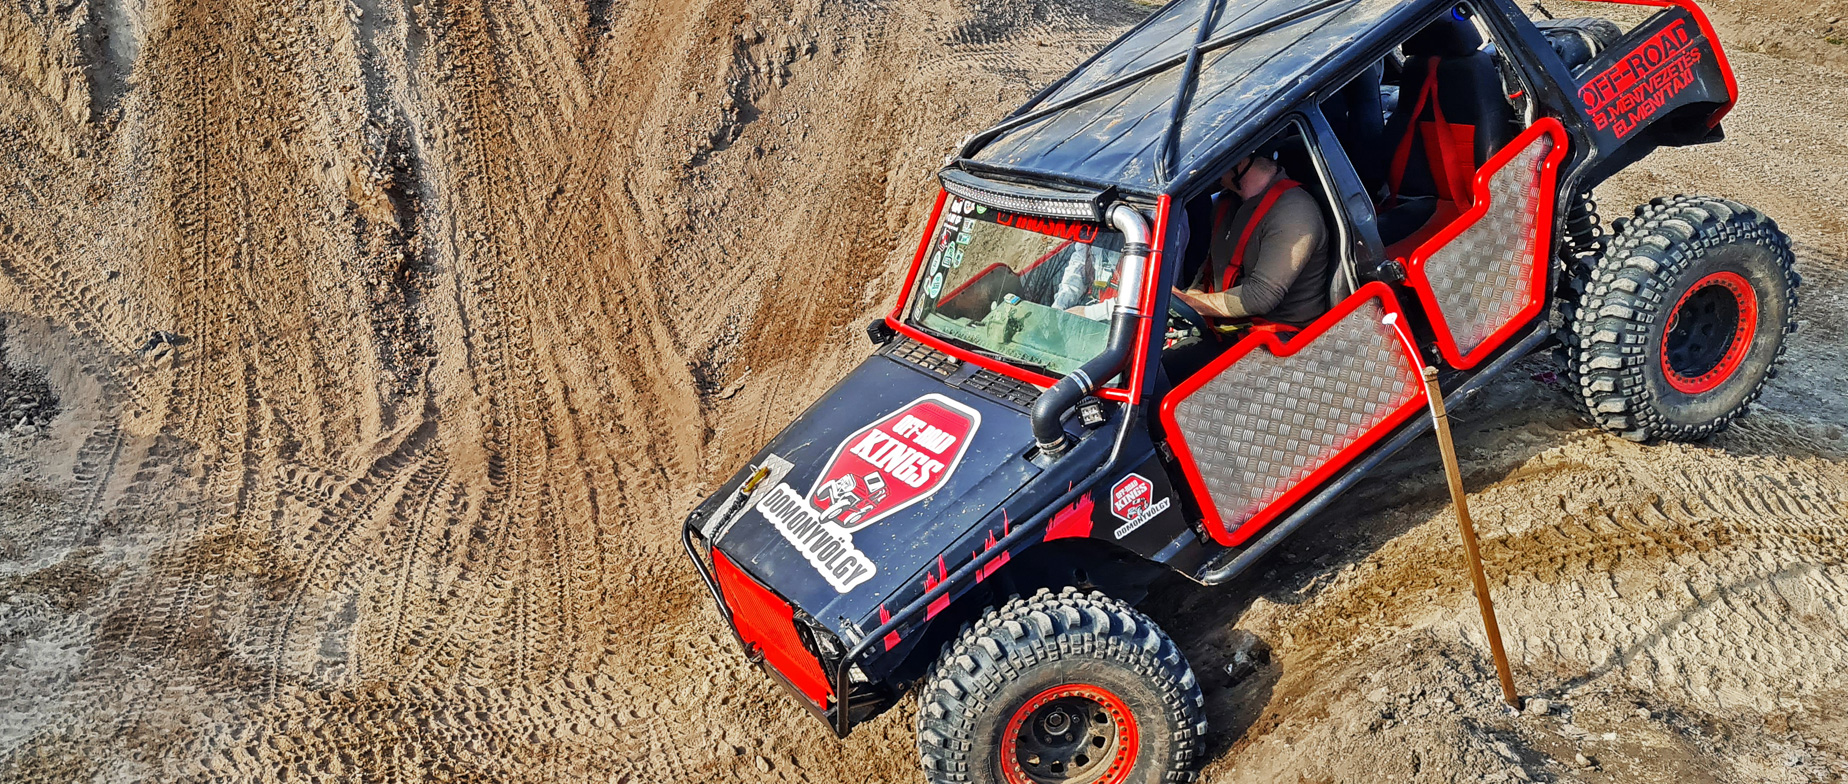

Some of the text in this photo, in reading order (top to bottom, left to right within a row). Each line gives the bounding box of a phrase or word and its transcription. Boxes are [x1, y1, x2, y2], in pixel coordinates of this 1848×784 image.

[1581, 24, 1690, 110] OFF-ROAD
[850, 428, 945, 488] KINGS
[892, 414, 957, 454] OFF-ROAD
[1114, 482, 1148, 511] KINGS
[1116, 480, 1138, 499] OFF-ROAD
[763, 488, 868, 586] DOMONYVÖLGY
